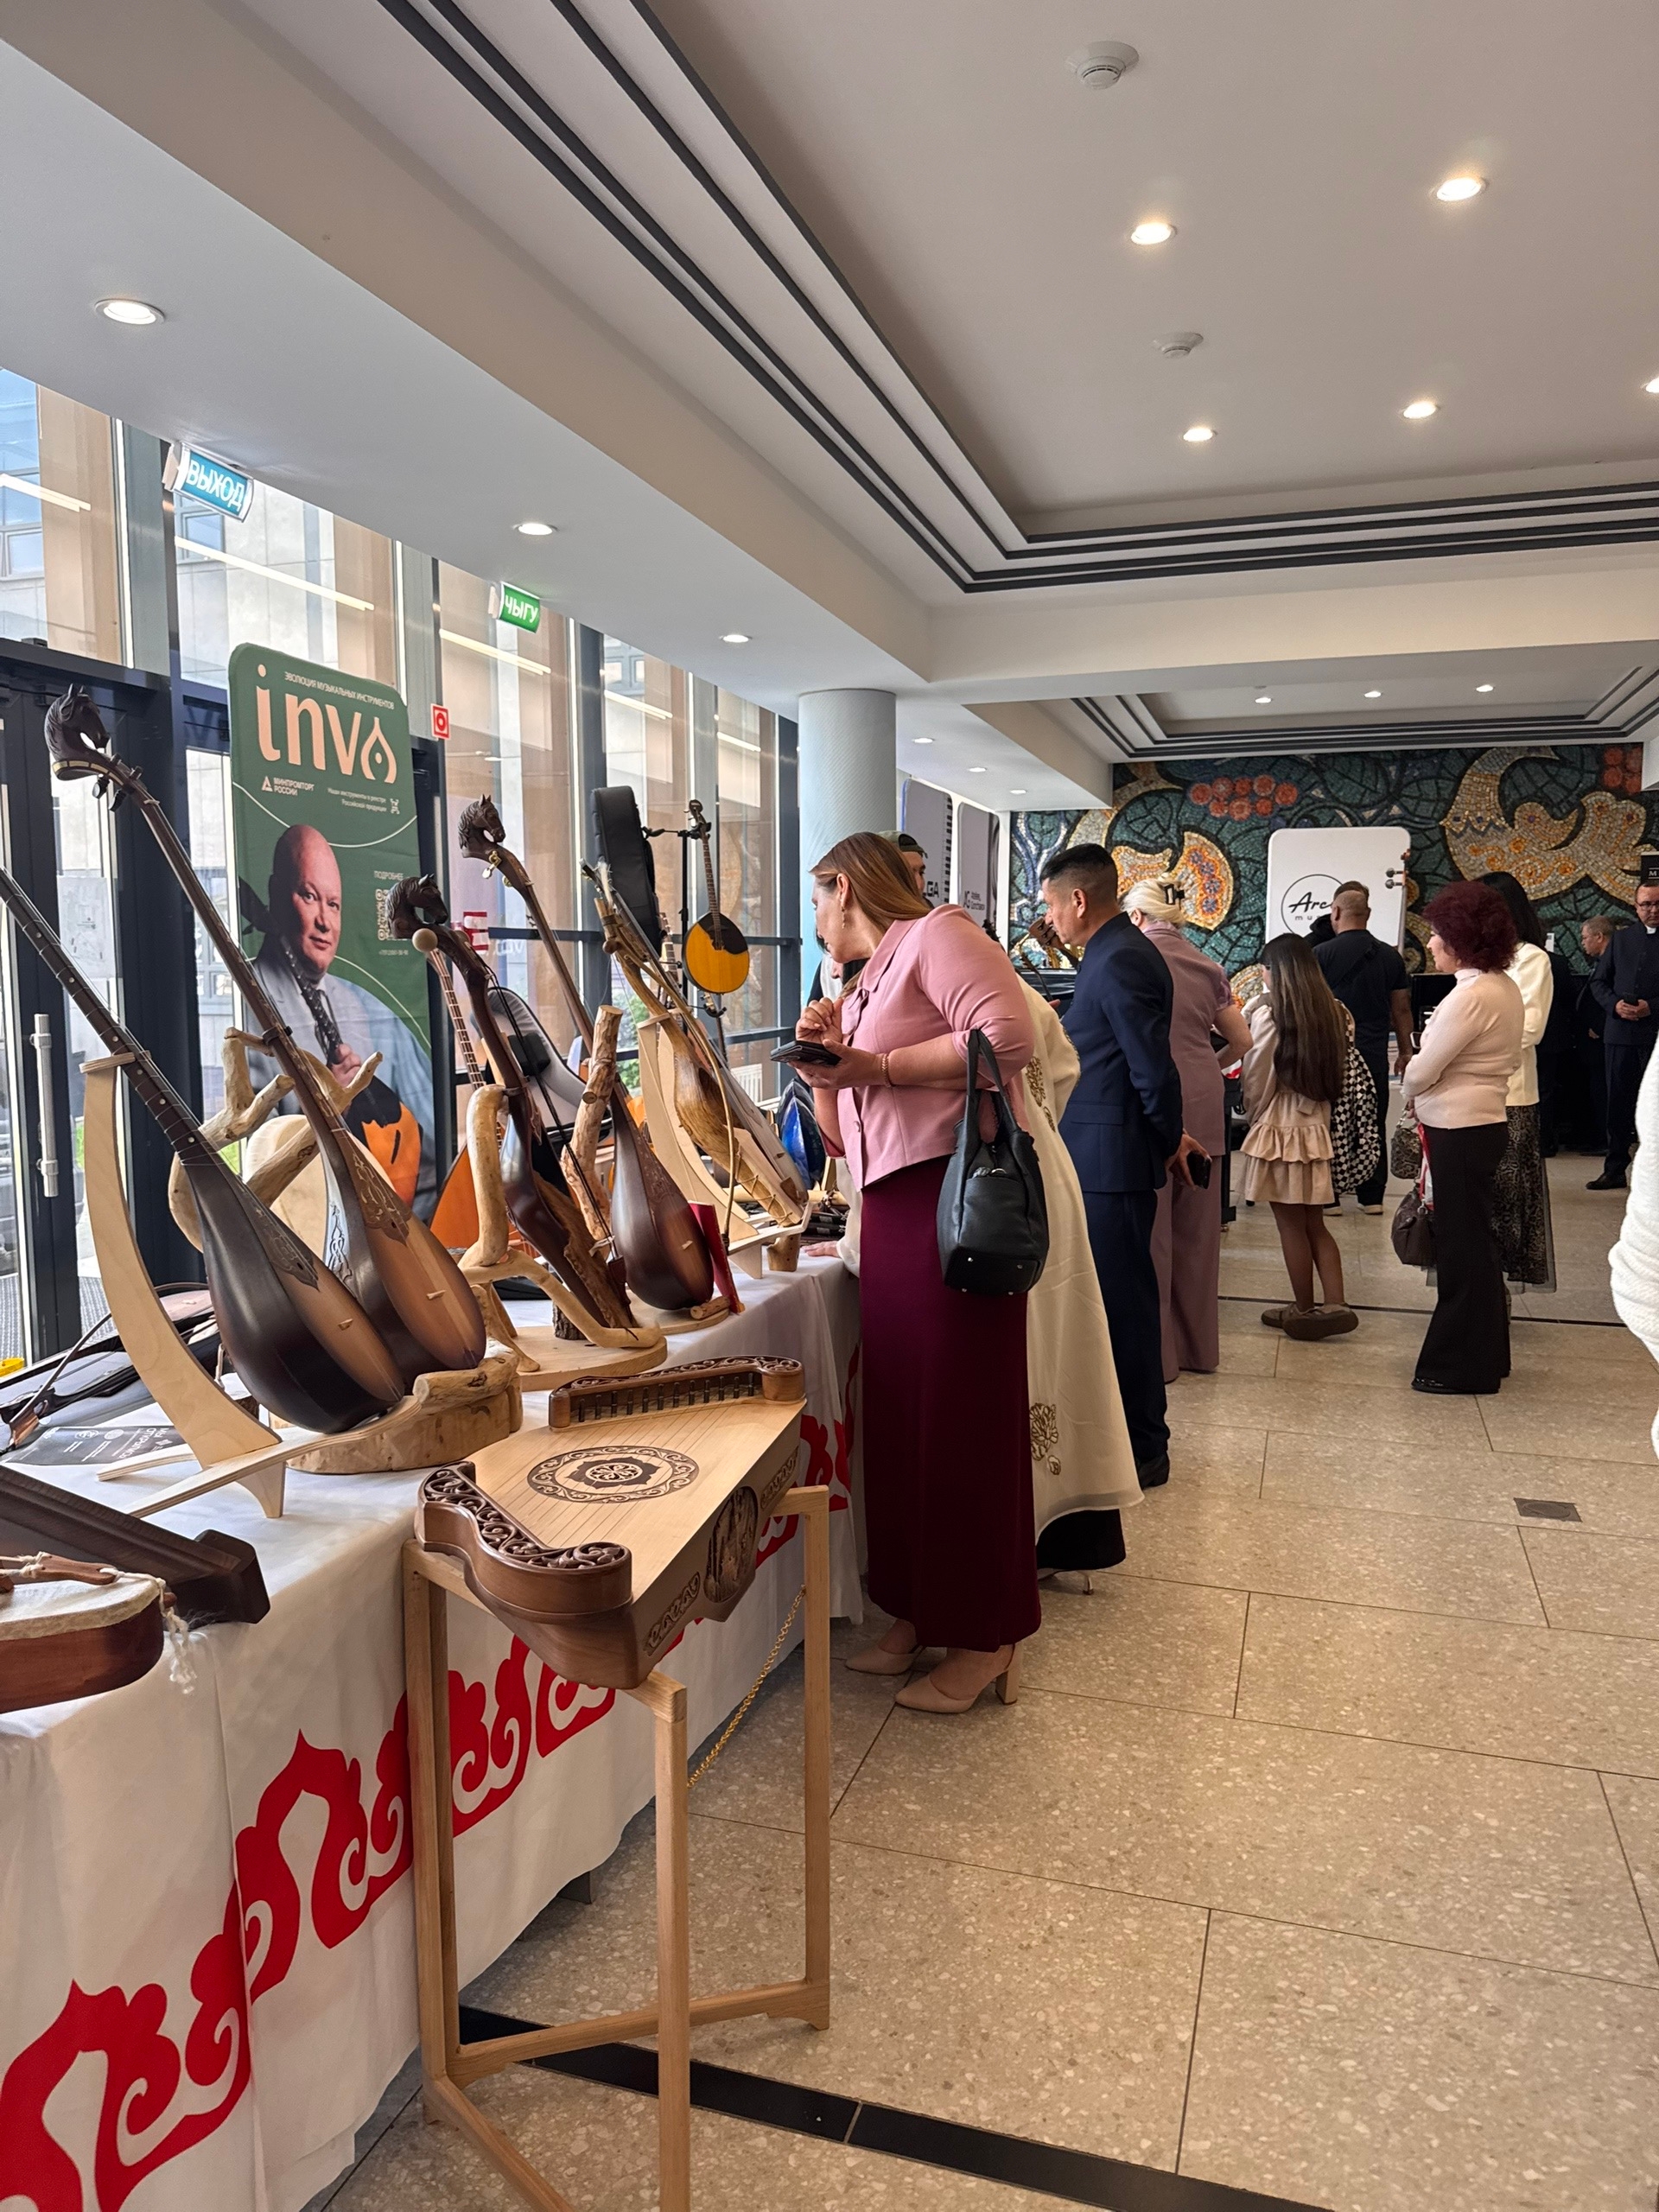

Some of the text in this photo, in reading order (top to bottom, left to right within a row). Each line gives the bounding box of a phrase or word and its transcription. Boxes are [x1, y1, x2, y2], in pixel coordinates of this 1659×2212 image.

[186, 459, 245, 512] ВЫХОД
[505, 594, 538, 623] ЧЫГУ
[284, 671, 395, 709] ЭВОЛЮЦИЯ МУЗЫКАЛЬНЫХ ИНСТРУМЕНТОВ
[274, 785, 298, 796] РОССИИ
[1288, 892, 1333, 913] Arc
